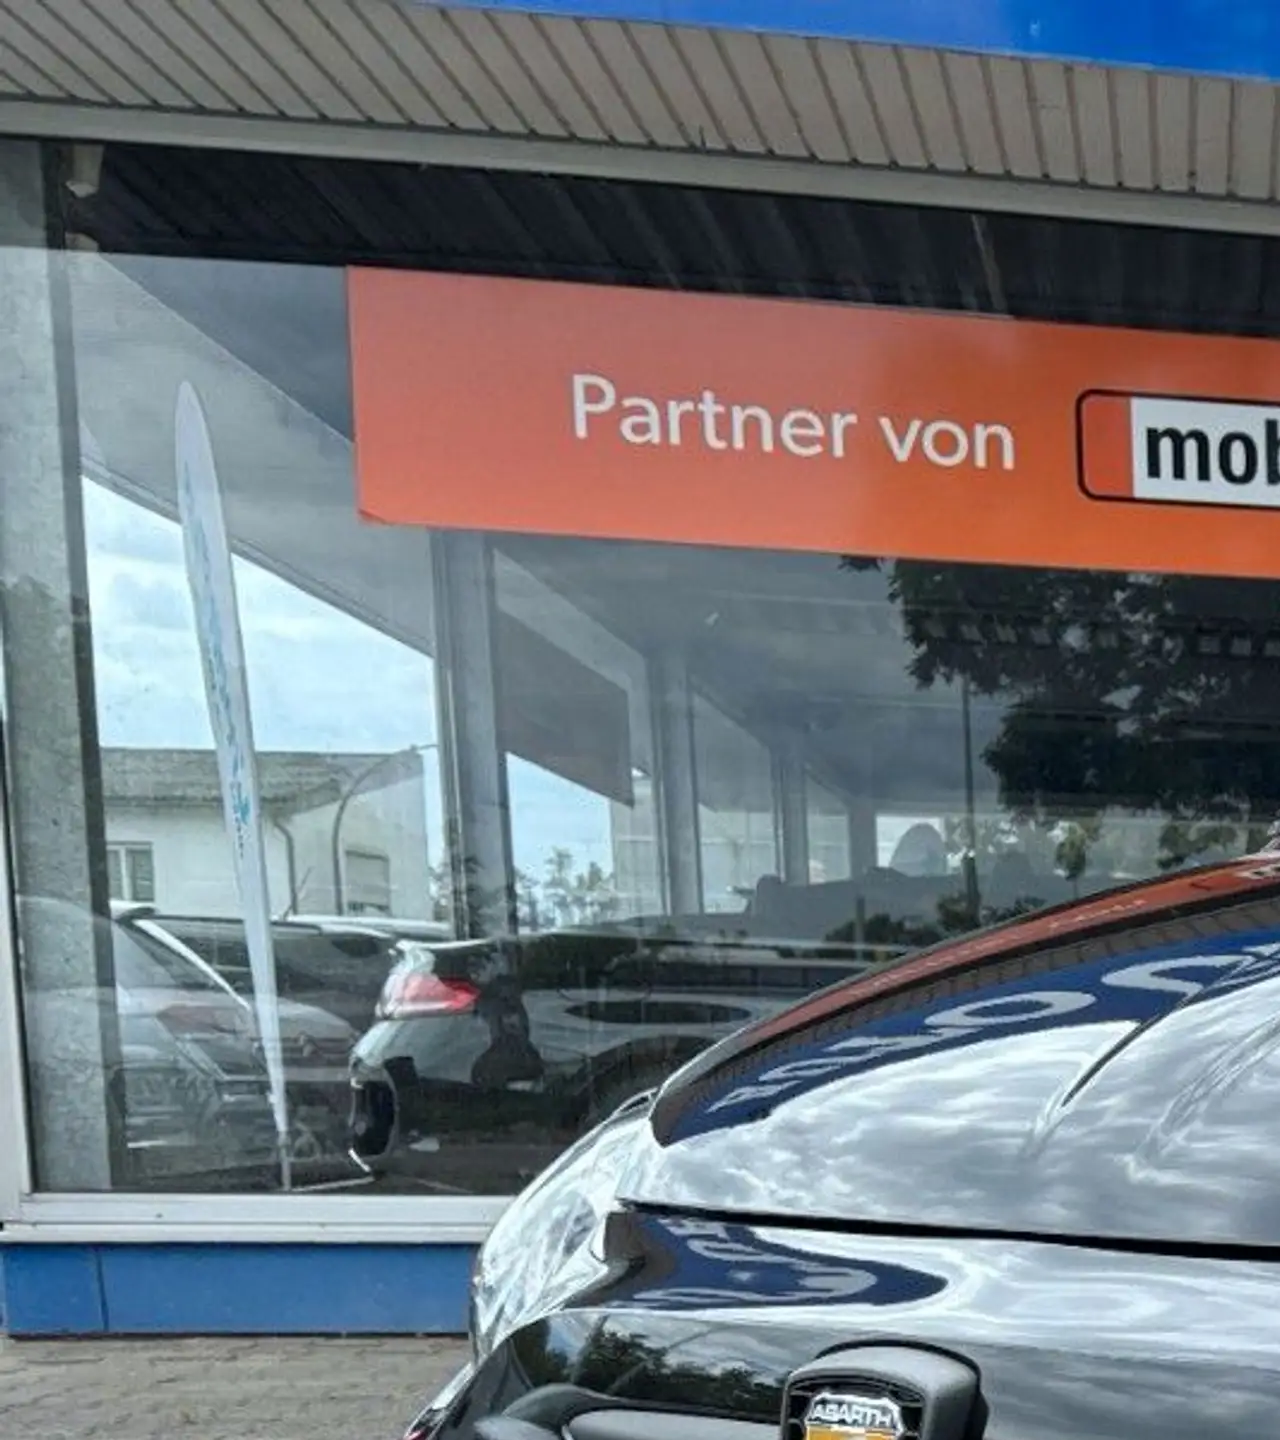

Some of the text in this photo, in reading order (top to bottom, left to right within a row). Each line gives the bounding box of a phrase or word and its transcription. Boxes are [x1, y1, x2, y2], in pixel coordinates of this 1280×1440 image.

[571, 374, 857, 460] Partner
[880, 414, 1016, 470] von
[812, 1402, 892, 1426] ABARTH
